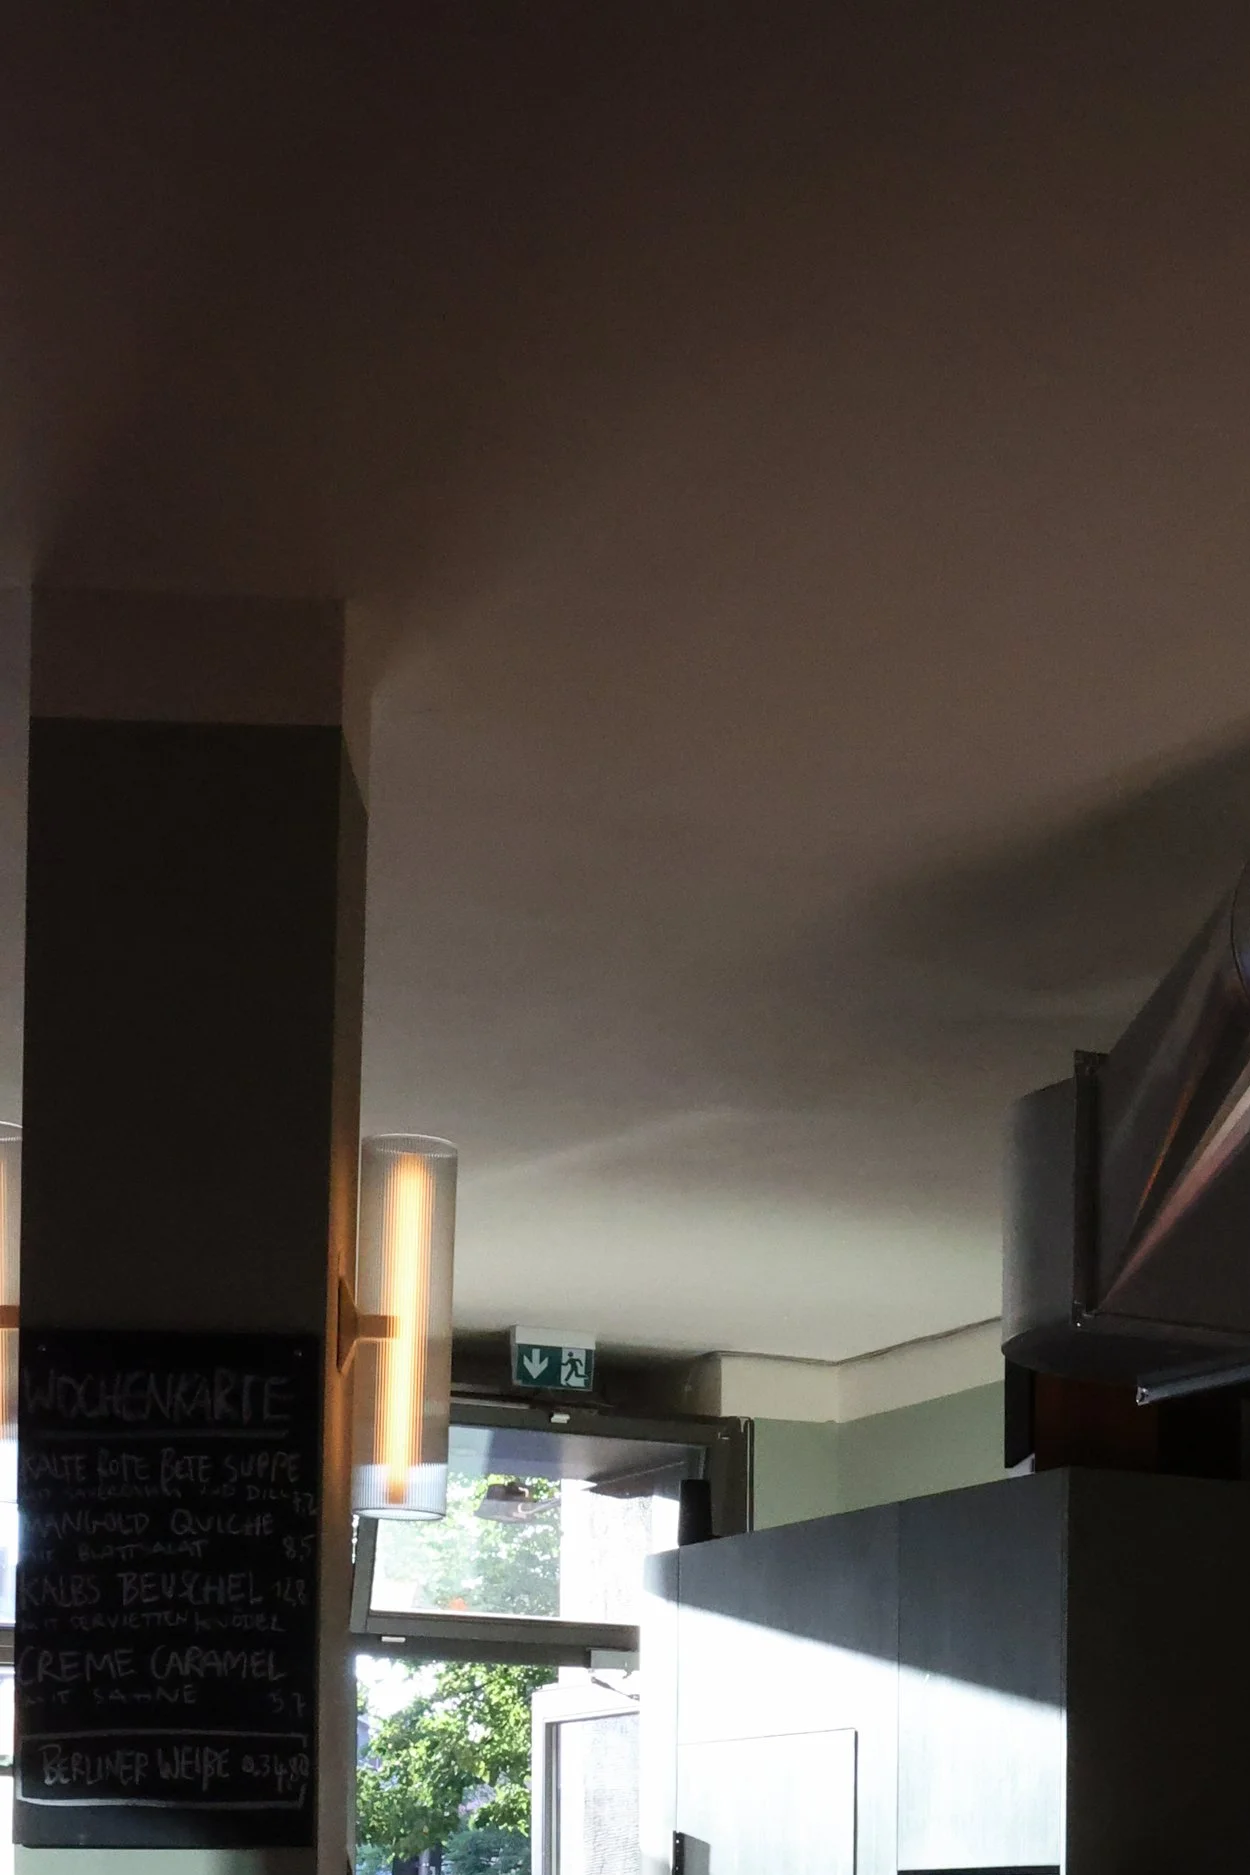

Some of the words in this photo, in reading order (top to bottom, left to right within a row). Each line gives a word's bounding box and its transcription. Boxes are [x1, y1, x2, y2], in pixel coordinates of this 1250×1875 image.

[22, 1366, 296, 1426] WOCHENKARTE
[20, 1452, 87, 1485] KALTE
[221, 1451, 302, 1483] SUPPE
[27, 1511, 150, 1540] MANGOLD
[170, 1508, 275, 1537] QUICHE
[18, 1571, 101, 1610] KALBS
[116, 1570, 264, 1608] BEUSCHEL
[16, 1645, 136, 1686] CREME
[149, 1644, 288, 1682] CARAMEL
[38, 1743, 149, 1787] BERLINER
